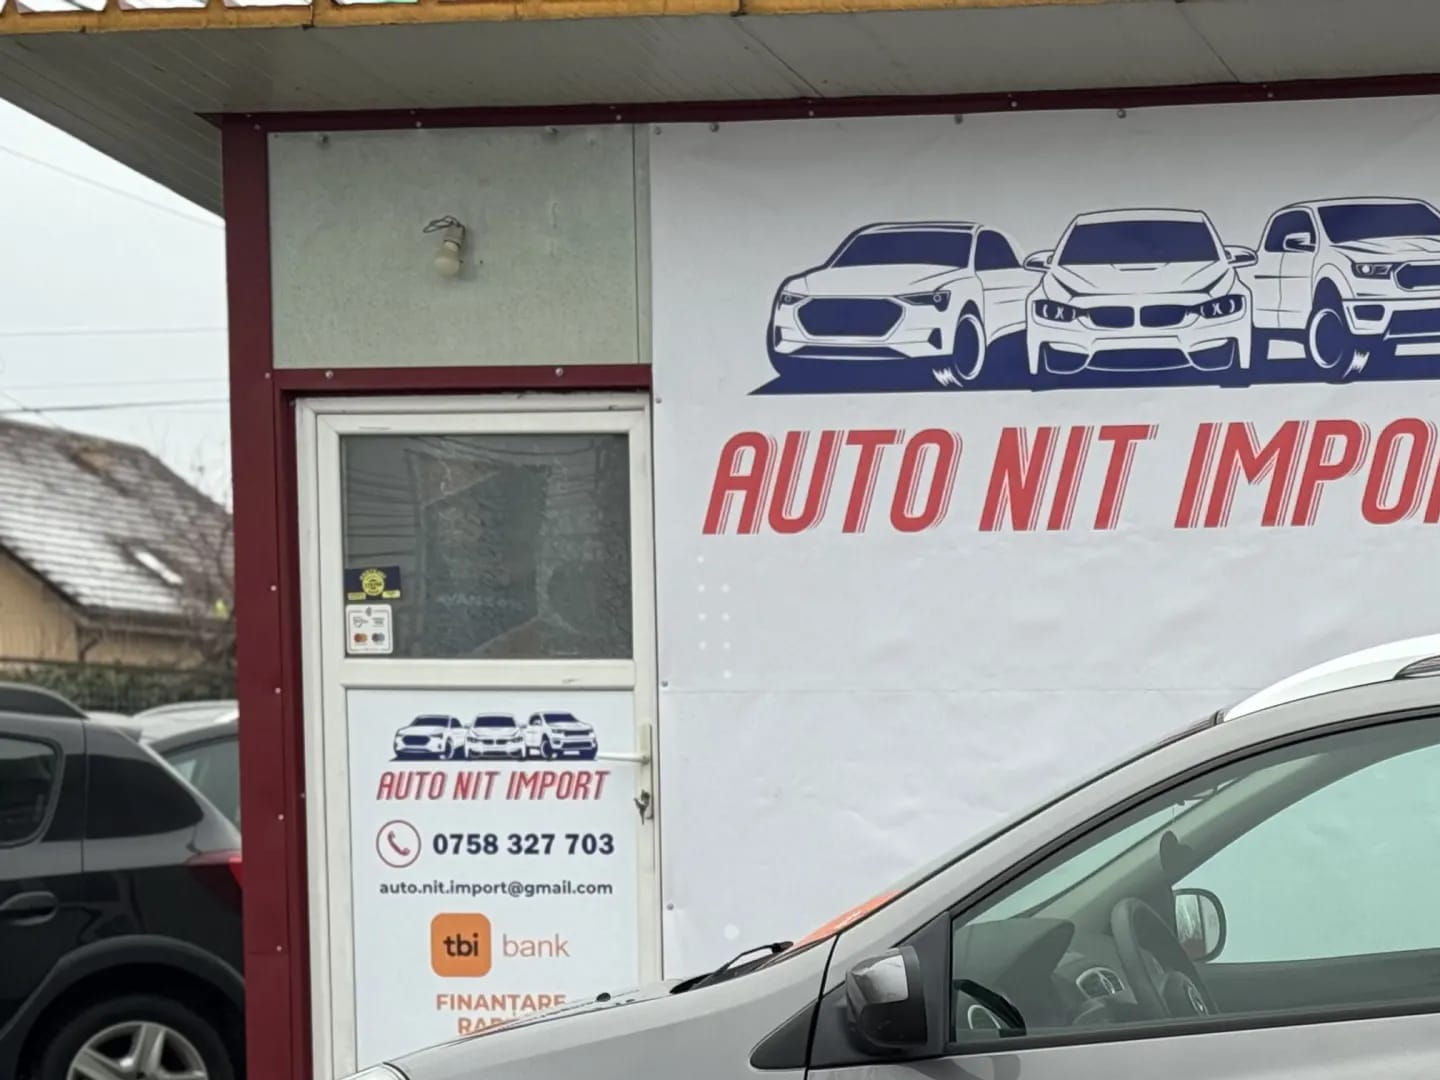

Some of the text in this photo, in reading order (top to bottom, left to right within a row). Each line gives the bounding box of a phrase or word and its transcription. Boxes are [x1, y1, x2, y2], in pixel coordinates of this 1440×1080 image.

[702, 428, 963, 536] AUTO
[978, 422, 1159, 532] NIT
[376, 770, 611, 800] AUTO NIT IMPORT
[432, 833, 615, 855] 0758 327 703
[379, 880, 613, 897] auto.nit.import@gmail.com
[442, 932, 570, 958] tbi bank
